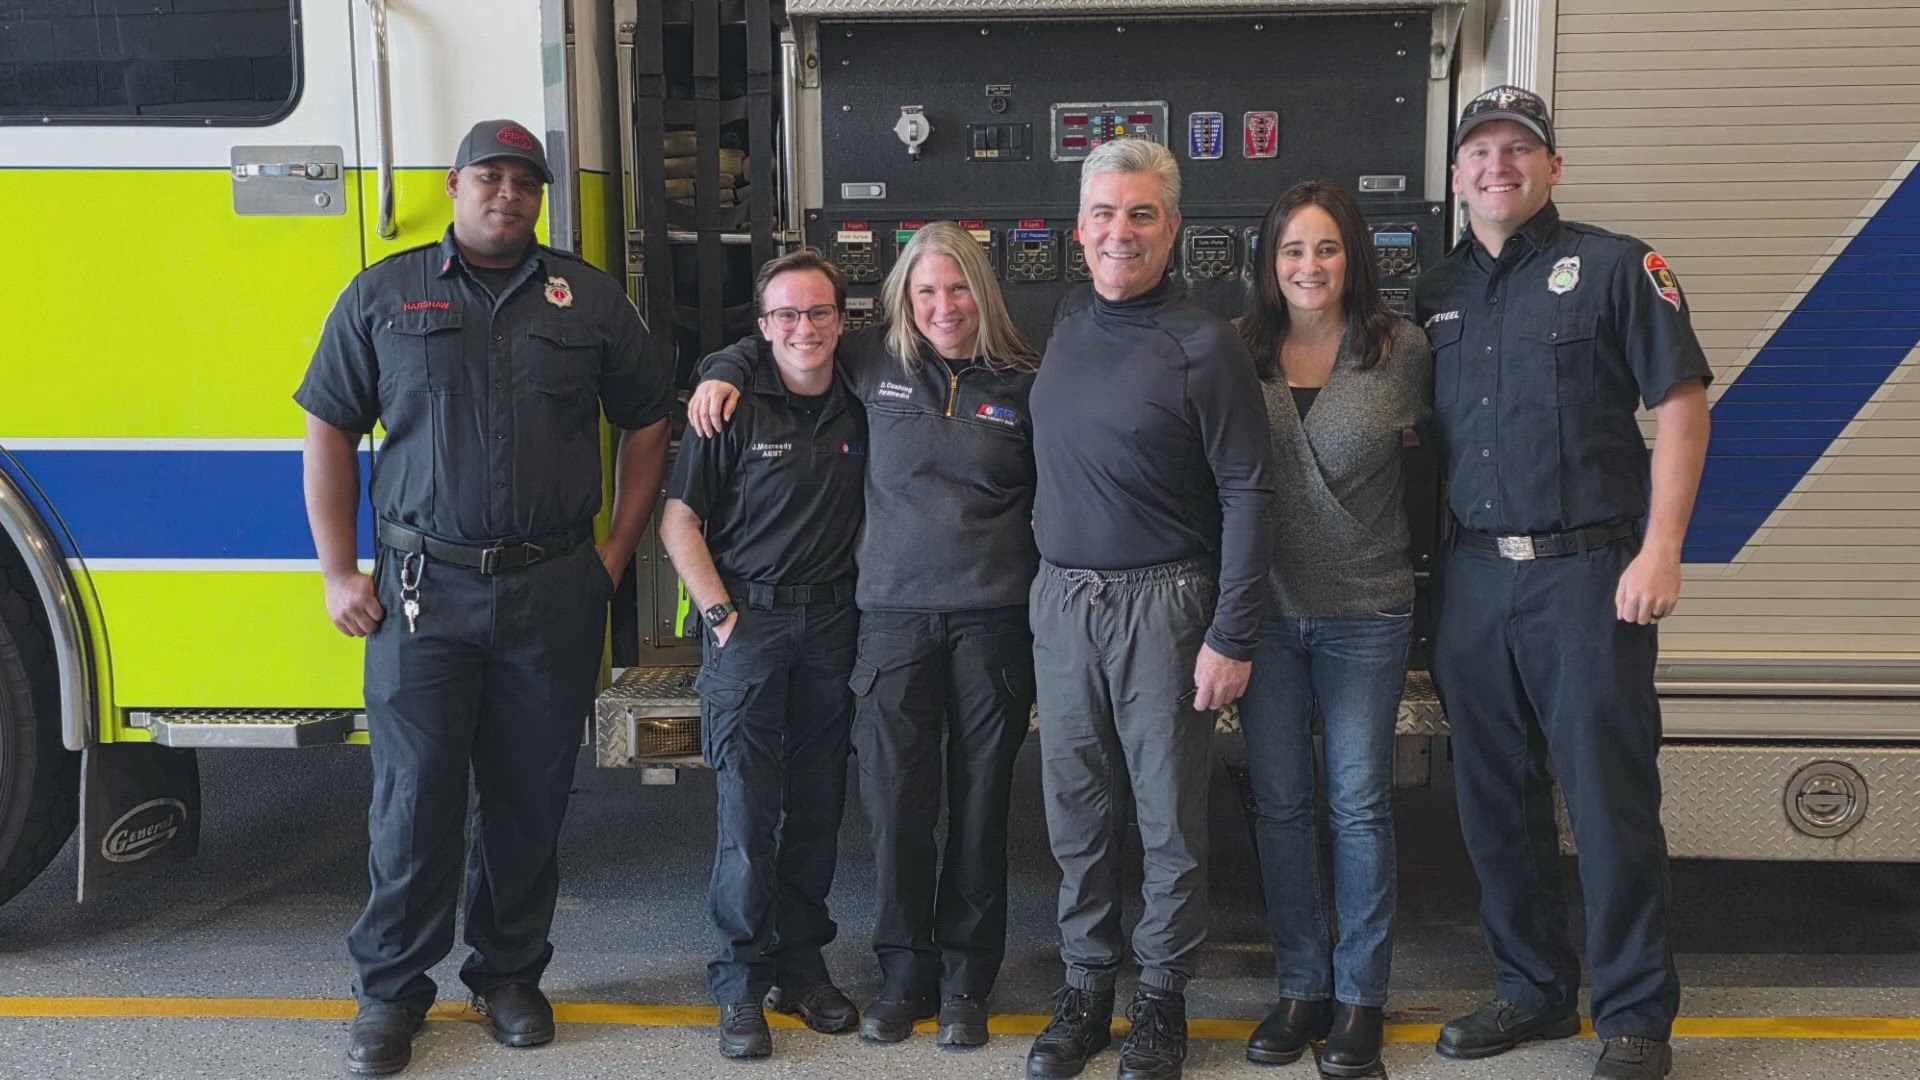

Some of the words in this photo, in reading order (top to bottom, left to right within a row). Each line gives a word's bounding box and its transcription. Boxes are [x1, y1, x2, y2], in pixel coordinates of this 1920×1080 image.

[403, 300, 450, 311] HARSHAW
[879, 388, 910, 400] Paramedic
[751, 442, 792, 452] J.Mccready
[762, 450, 783, 458] AEMT
[109, 813, 174, 854] General
